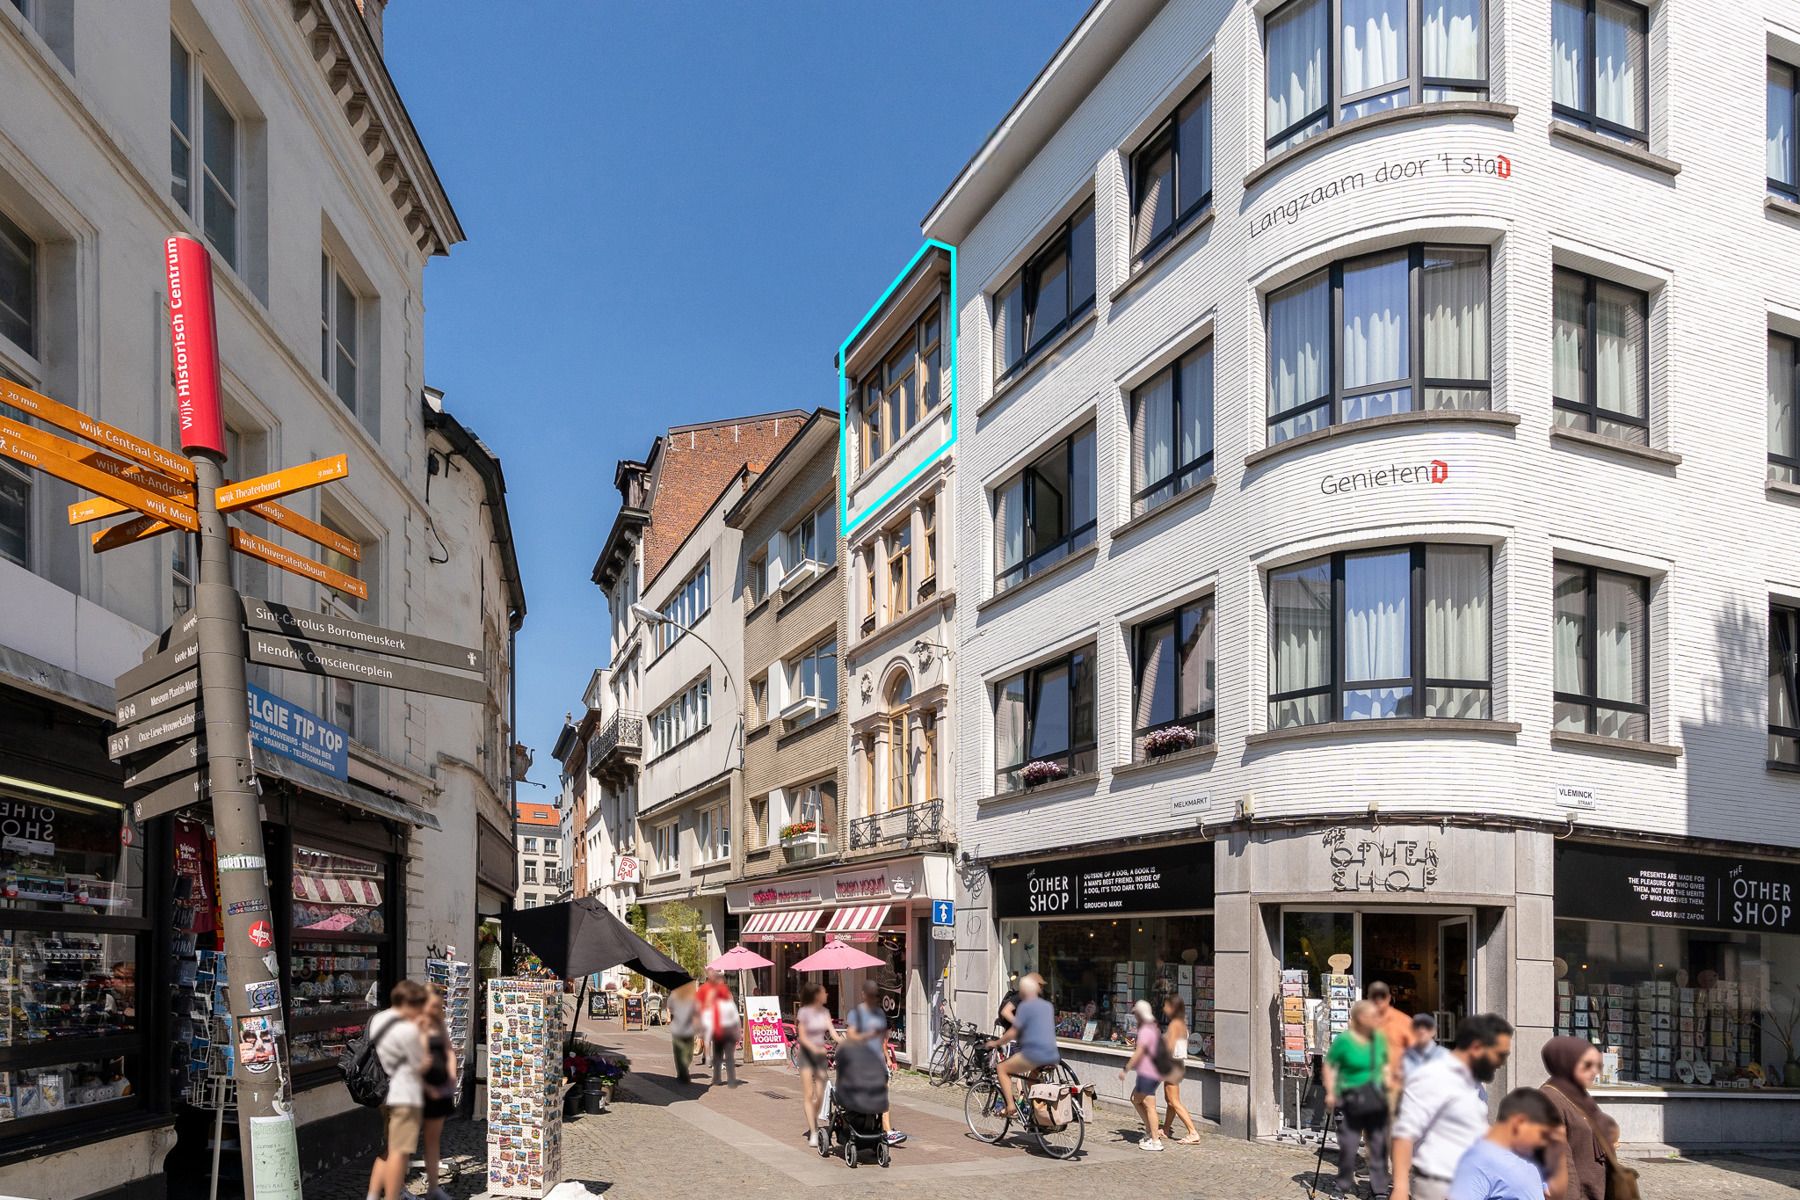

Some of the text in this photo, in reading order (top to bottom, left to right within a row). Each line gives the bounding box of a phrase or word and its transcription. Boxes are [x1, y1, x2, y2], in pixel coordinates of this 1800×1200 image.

[1249, 172, 1364, 238] Langzaam
[1375, 158, 1429, 183] door
[1437, 153, 1452, 173] 't
[165, 237, 193, 430] Wijk Historisch Centrum
[8, 391, 19, 401] 20
[12, 445, 18, 453] 6
[79, 420, 190, 475] wijk Centraal Station
[96, 458, 188, 499] wijk Sint-Andries
[219, 479, 281, 504] wijk Theaterbuurt
[146, 499, 193, 523] wijk Meir
[239, 536, 327, 579] wijk Universiteitsbuurt
[255, 607, 406, 650] Sint-Carolus Borromeuskerk
[258, 641, 393, 680] Hendrik Conscienceplein
[293, 713, 315, 740] TIP
[318, 725, 343, 753] TOP
[269, 727, 298, 746] SOUVENIRS
[301, 741, 321, 755] BELGIUM
[321, 750, 332, 760] BIER
[263, 737, 289, 752] DRANKEN
[293, 748, 336, 772] TELEFOONKAARTEN
[1559, 788, 1593, 799] VLEMINCK
[1173, 796, 1208, 809] MELKMARKT
[1026, 868, 1036, 879] THE
[1083, 872, 1103, 880] OUTSIDE
[1134, 875, 1152, 883] INSIDE
[1153, 873, 1161, 881] OF
[1640, 870, 1667, 879] PRESENTS
[1729, 864, 1743, 878] THE
[860, 874, 885, 894] yogurt
[1029, 875, 1069, 894] OTHER
[1101, 885, 1110, 893] IT'S
[1110, 884, 1121, 892] TOO
[1122, 883, 1136, 891] DARK
[1136, 882, 1143, 890] TO
[1144, 881, 1160, 889] READ.
[1628, 877, 1639, 885] THE
[1640, 878, 1667, 887] PLEASURE
[1733, 878, 1791, 902] OTHER
[1633, 885, 1650, 894] THEM,
[1686, 890, 1705, 898] MERITS
[1640, 893, 1648, 901] OF
[1649, 894, 1662, 902] WHO
[1663, 895, 1688, 904] RECEIVES
[1029, 892, 1070, 912] SHOP
[1083, 900, 1123, 909] GROUCHO MARX
[1651, 910, 1672, 918] CARLOS
[1673, 911, 1685, 919] RUIZ
[1732, 901, 1792, 927] SHOP
[752, 1028, 779, 1037] FROZEN
[753, 1035, 782, 1043] YOGURT
